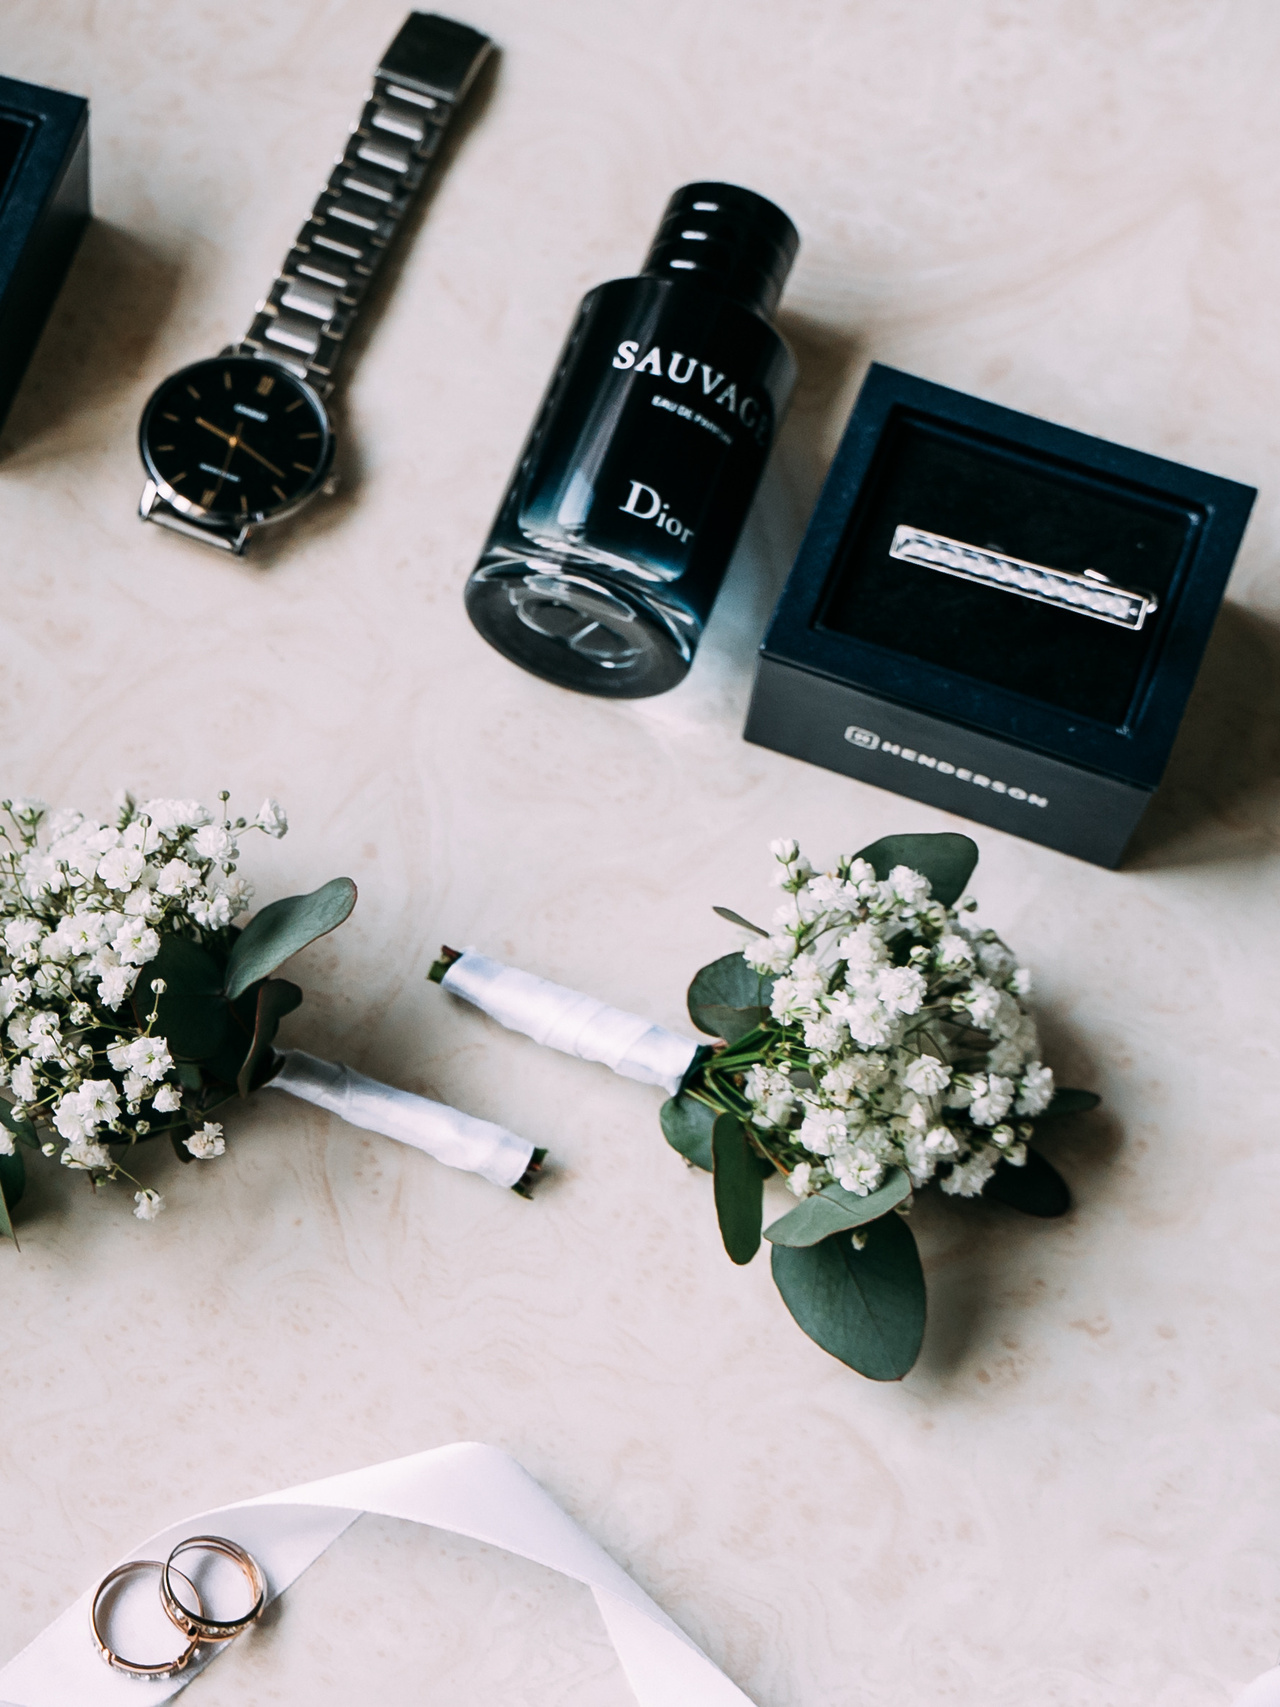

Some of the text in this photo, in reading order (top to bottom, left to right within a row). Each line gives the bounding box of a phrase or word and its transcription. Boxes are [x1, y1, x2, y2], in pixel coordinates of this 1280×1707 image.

[651, 394, 678, 412] EAU
[676, 403, 694, 421] DE
[618, 480, 695, 544] Dior
[881, 740, 1049, 808] HENDERSON
